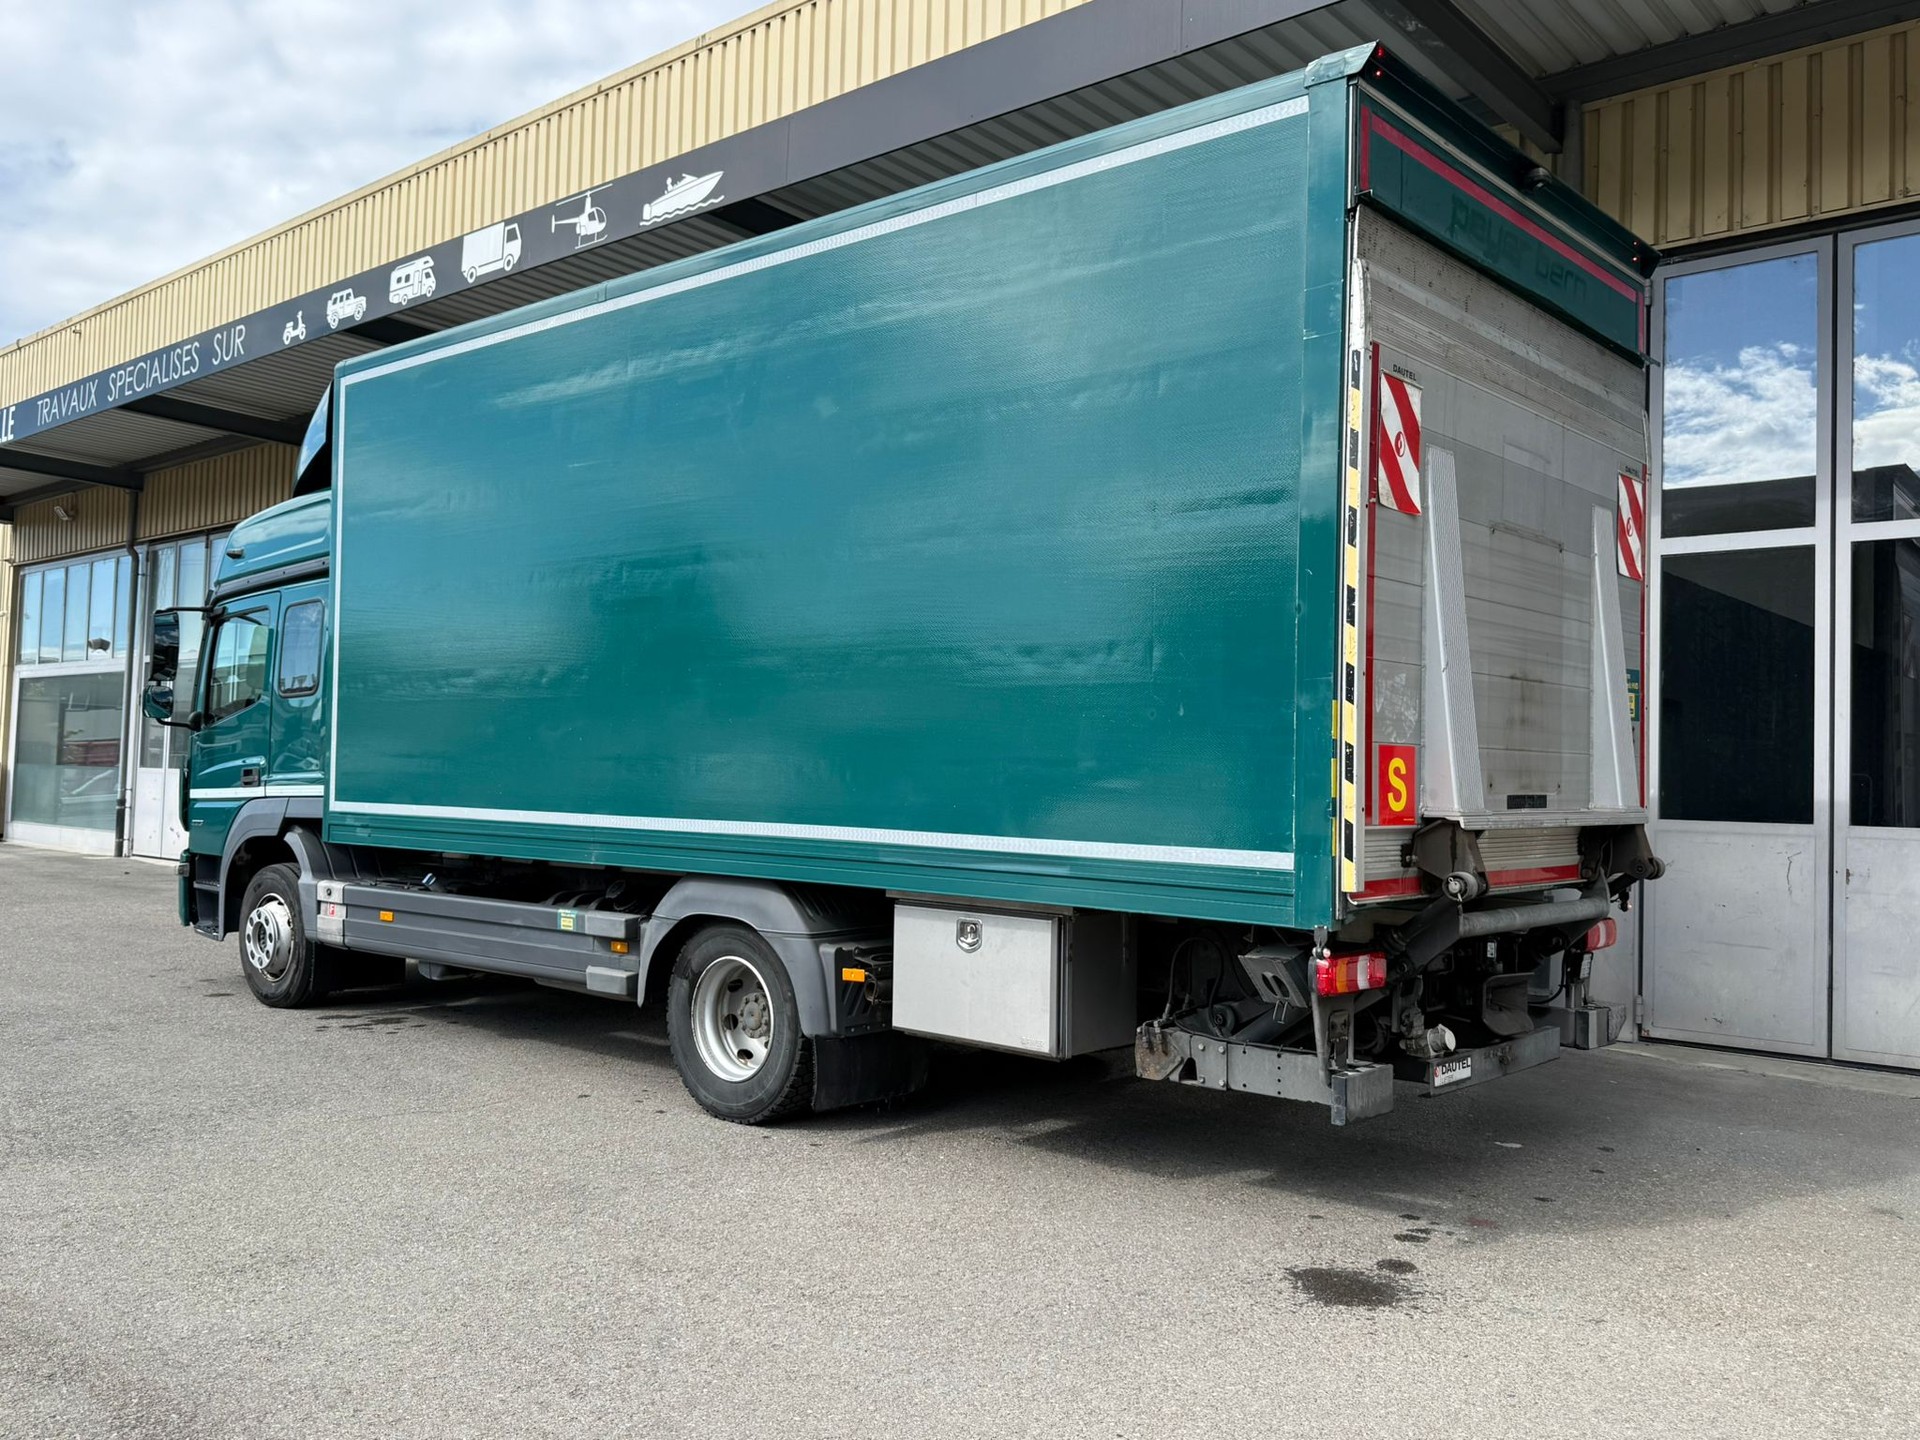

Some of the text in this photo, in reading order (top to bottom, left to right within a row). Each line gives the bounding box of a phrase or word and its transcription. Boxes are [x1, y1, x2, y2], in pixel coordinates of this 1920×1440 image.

[0, 324, 246, 443] LE TRAVAUX SPECIALISES SUR
[1392, 363, 1417, 382] DAUTEL
[1387, 757, 1408, 813] S
[1441, 1057, 1471, 1075] DAUTEL
